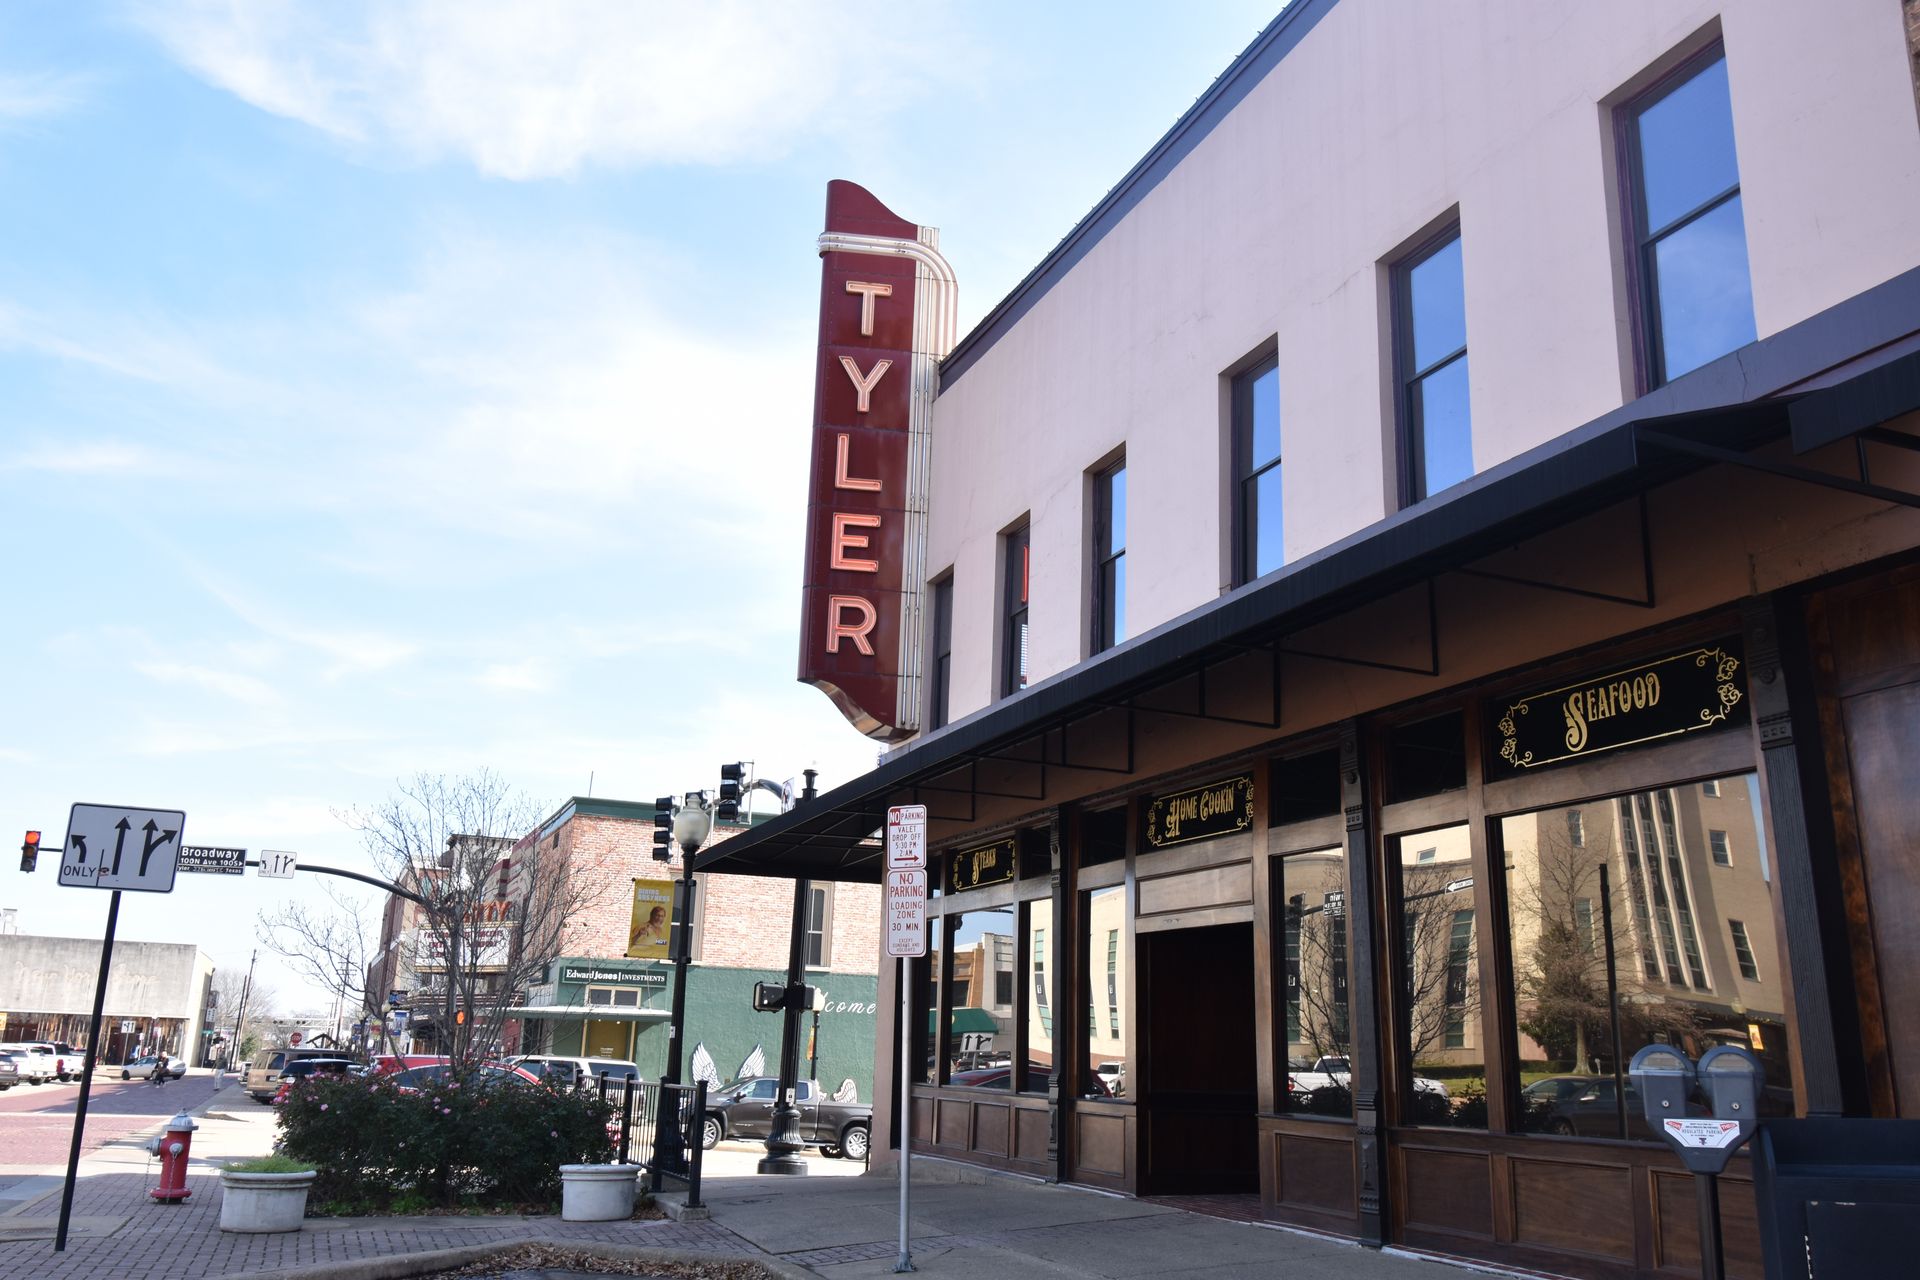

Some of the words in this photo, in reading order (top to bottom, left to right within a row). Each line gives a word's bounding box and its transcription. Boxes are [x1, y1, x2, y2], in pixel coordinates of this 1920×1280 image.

[825, 280, 893, 656] TYLER
[890, 811, 900, 823] NO
[901, 811, 924, 820] PARKING
[892, 834, 908, 842] DROP
[911, 833, 921, 841] OFF
[181, 847, 239, 860] Broadway
[180, 857, 200, 865] 100N
[63, 865, 97, 878] ONLY
[899, 873, 914, 884] NO
[890, 885, 923, 898] PARKING
[890, 901, 923, 910] LOADING
[896, 910, 916, 919] ZONE
[892, 922, 902, 931] 30
[905, 922, 921, 931] MIN.
[566, 969, 594, 979] Edward
[594, 970, 618, 980] Jones
[621, 974, 665, 982] INVESTMENTS
[824, 992, 877, 1014] come
